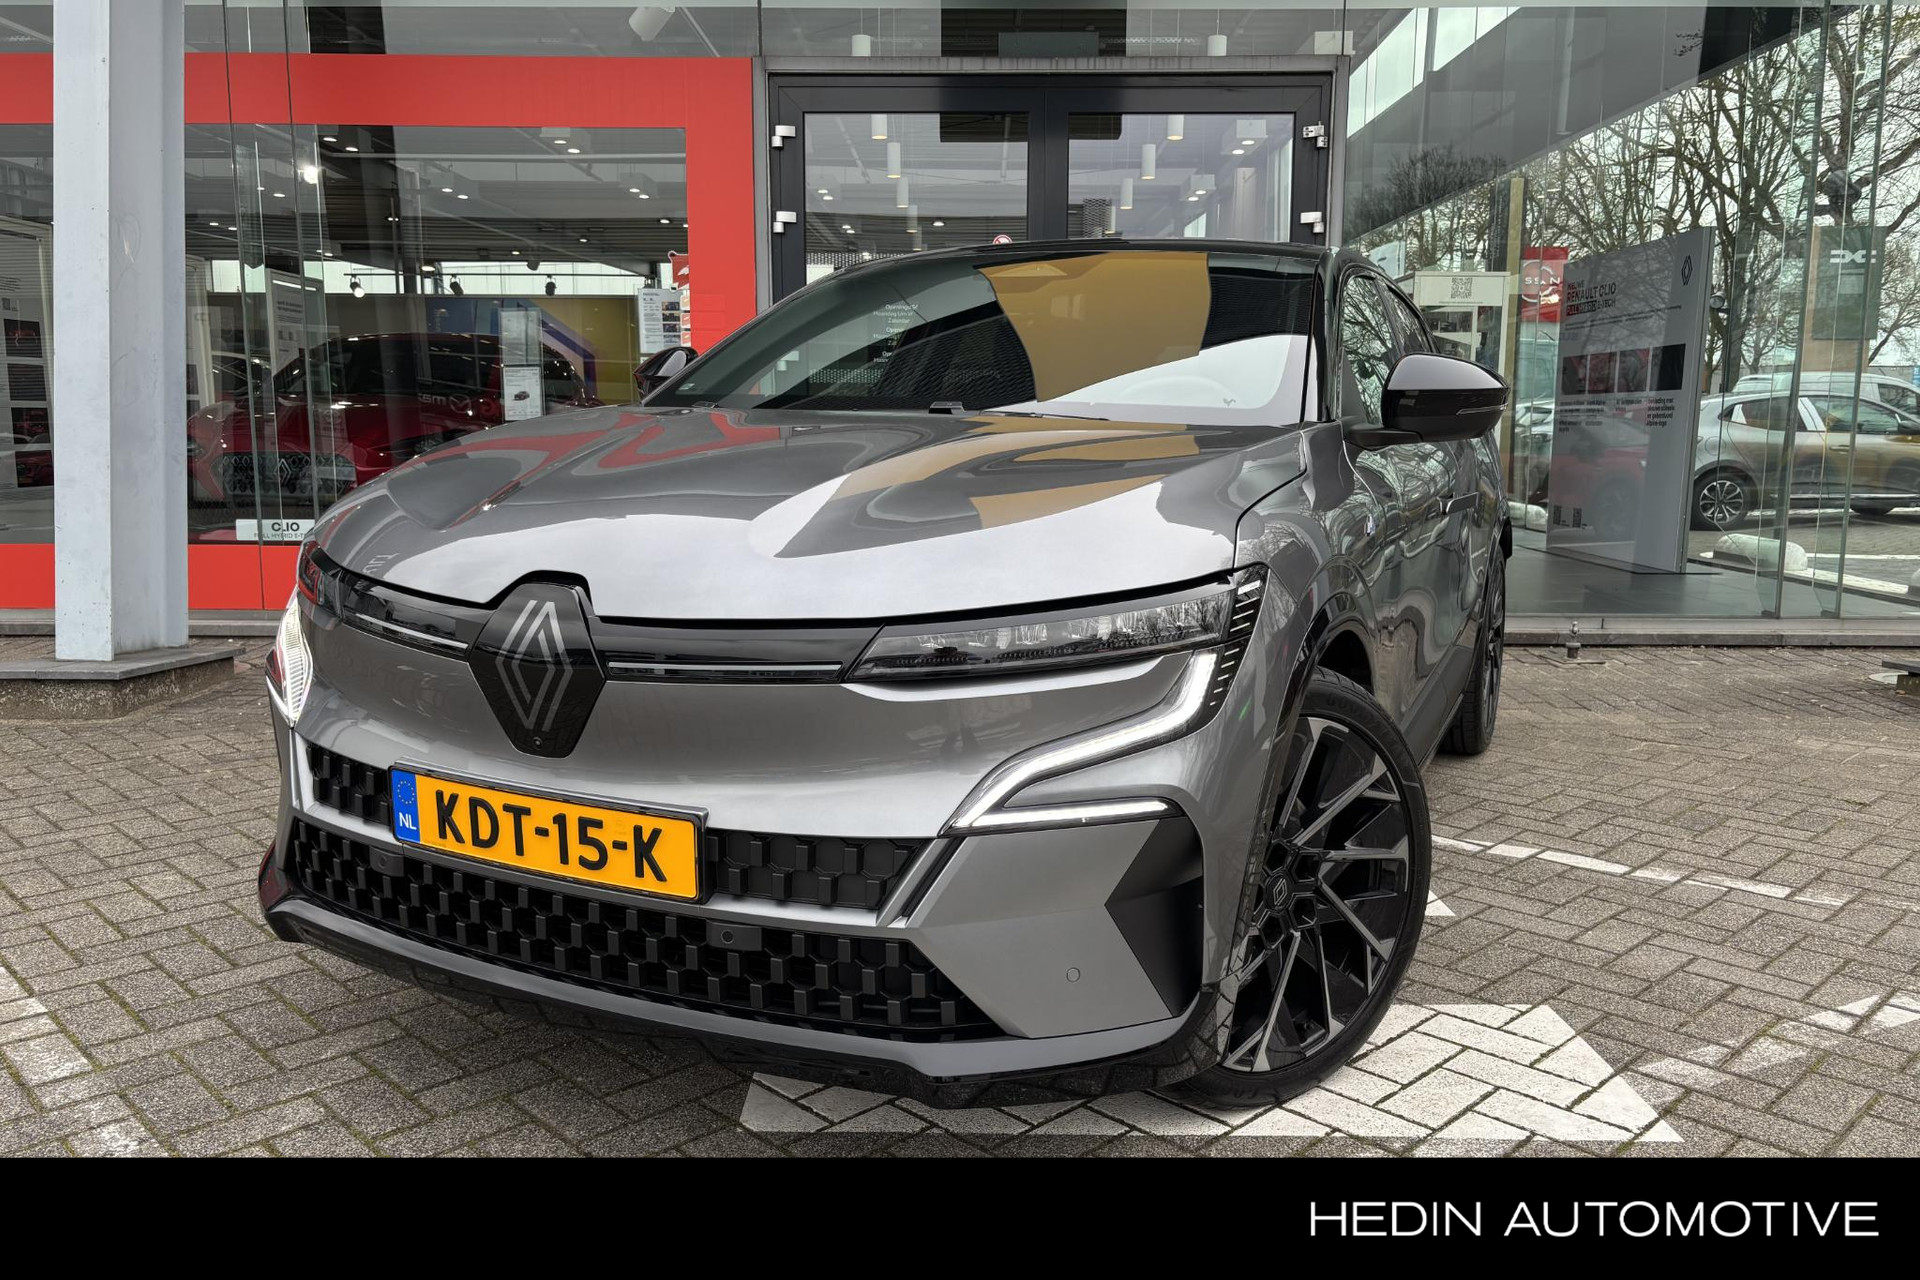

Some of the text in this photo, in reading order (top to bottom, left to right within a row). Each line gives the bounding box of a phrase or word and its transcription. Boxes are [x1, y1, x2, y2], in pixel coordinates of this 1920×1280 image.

[1566, 281, 1617, 303] RENAULT CLIO
[399, 811, 417, 831] NL
[435, 789, 667, 882] KDT-15-K
